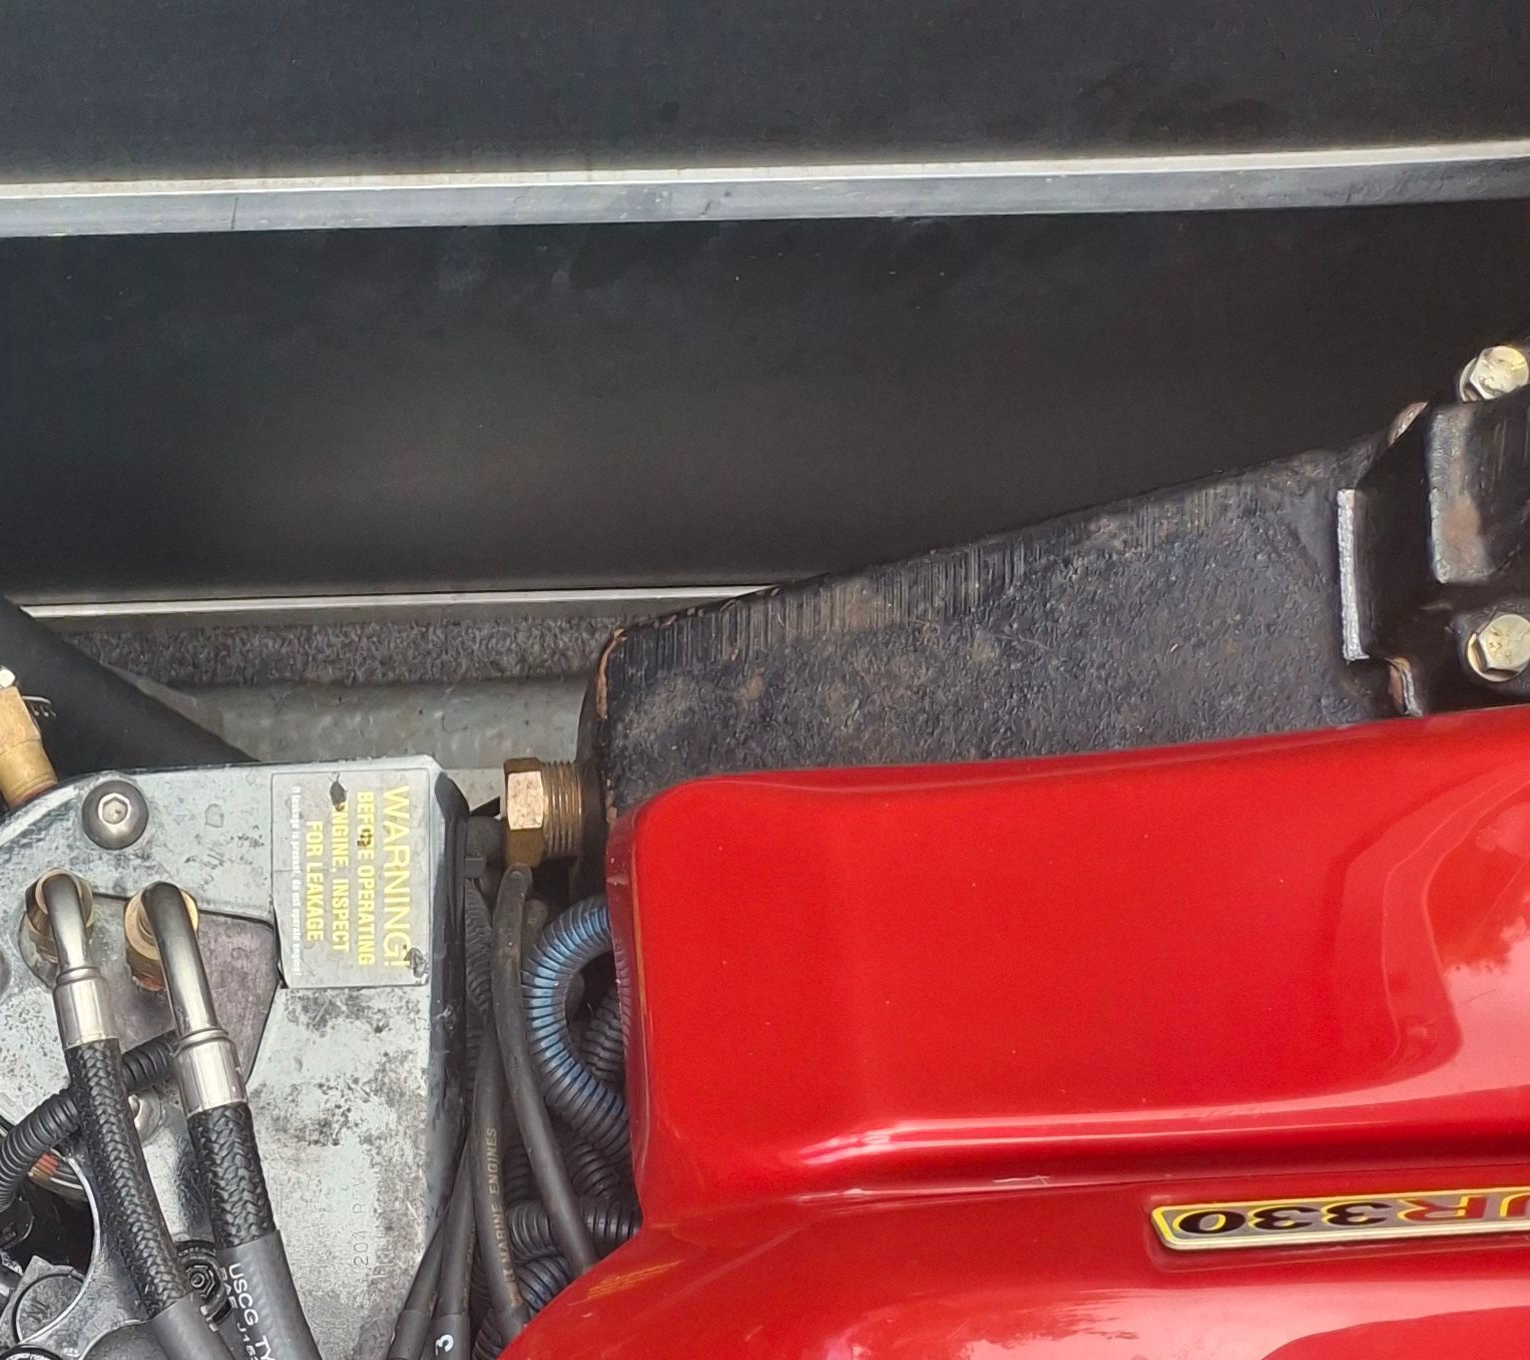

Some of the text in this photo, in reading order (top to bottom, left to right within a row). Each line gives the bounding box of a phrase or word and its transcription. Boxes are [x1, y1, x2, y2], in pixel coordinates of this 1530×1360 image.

[306, 821, 324, 942] FOR LEAKAGE
[331, 804, 350, 953] NGINE, INSPECT
[357, 864, 376, 965] OPERATING
[383, 785, 411, 968] WARNING!
[485, 1127, 500, 1194] ENGINES
[228, 1263, 259, 1326] USCG
